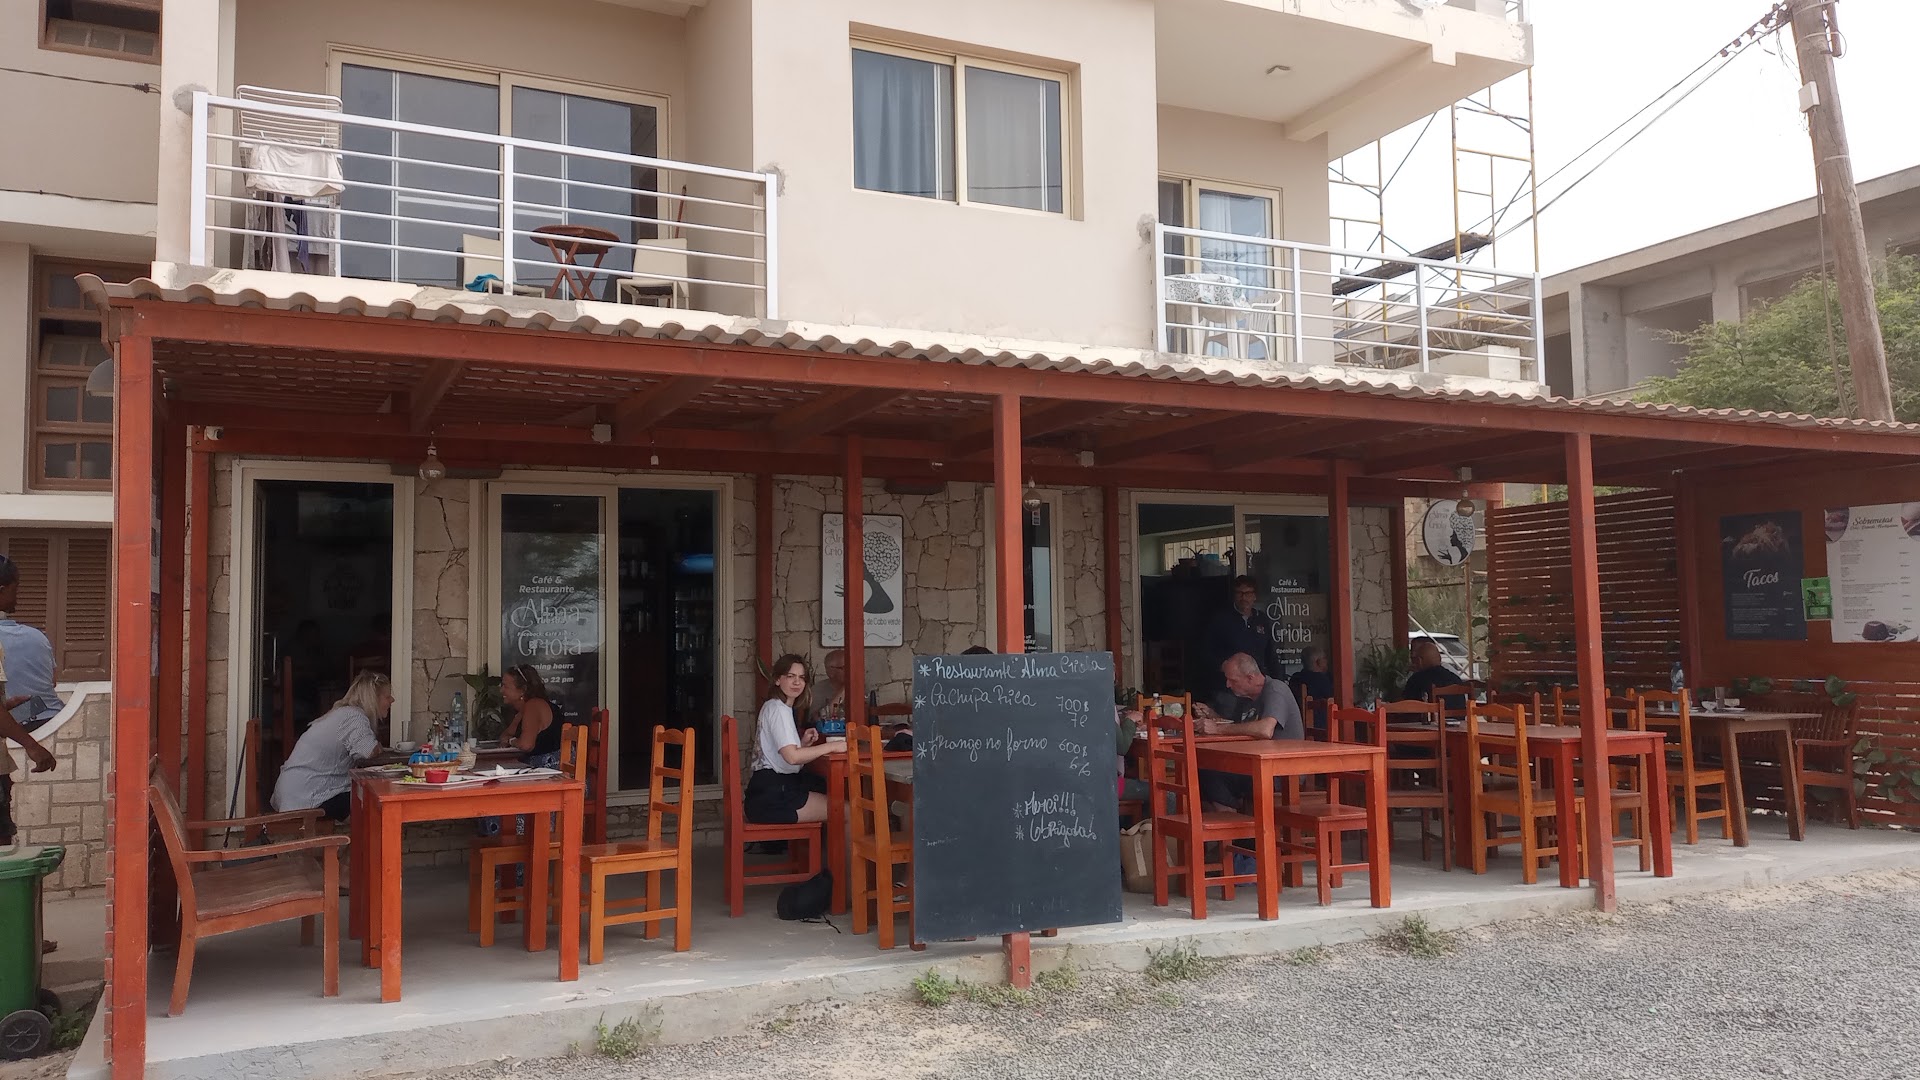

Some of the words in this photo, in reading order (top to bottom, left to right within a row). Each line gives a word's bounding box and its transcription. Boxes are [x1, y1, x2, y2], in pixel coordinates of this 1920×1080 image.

[825, 545, 843, 556] Crio
[532, 575, 553, 584] Café
[555, 575, 563, 584] &
[1743, 568, 1778, 588] Tacos
[519, 585, 575, 593] Restaurante
[511, 598, 580, 628] Alma
[1266, 596, 1310, 621] Alma
[553, 662, 574, 670] hours
[932, 657, 1015, 679] Restaurante
[986, 737, 1001, 750] no
[1007, 727, 1048, 761] forno
